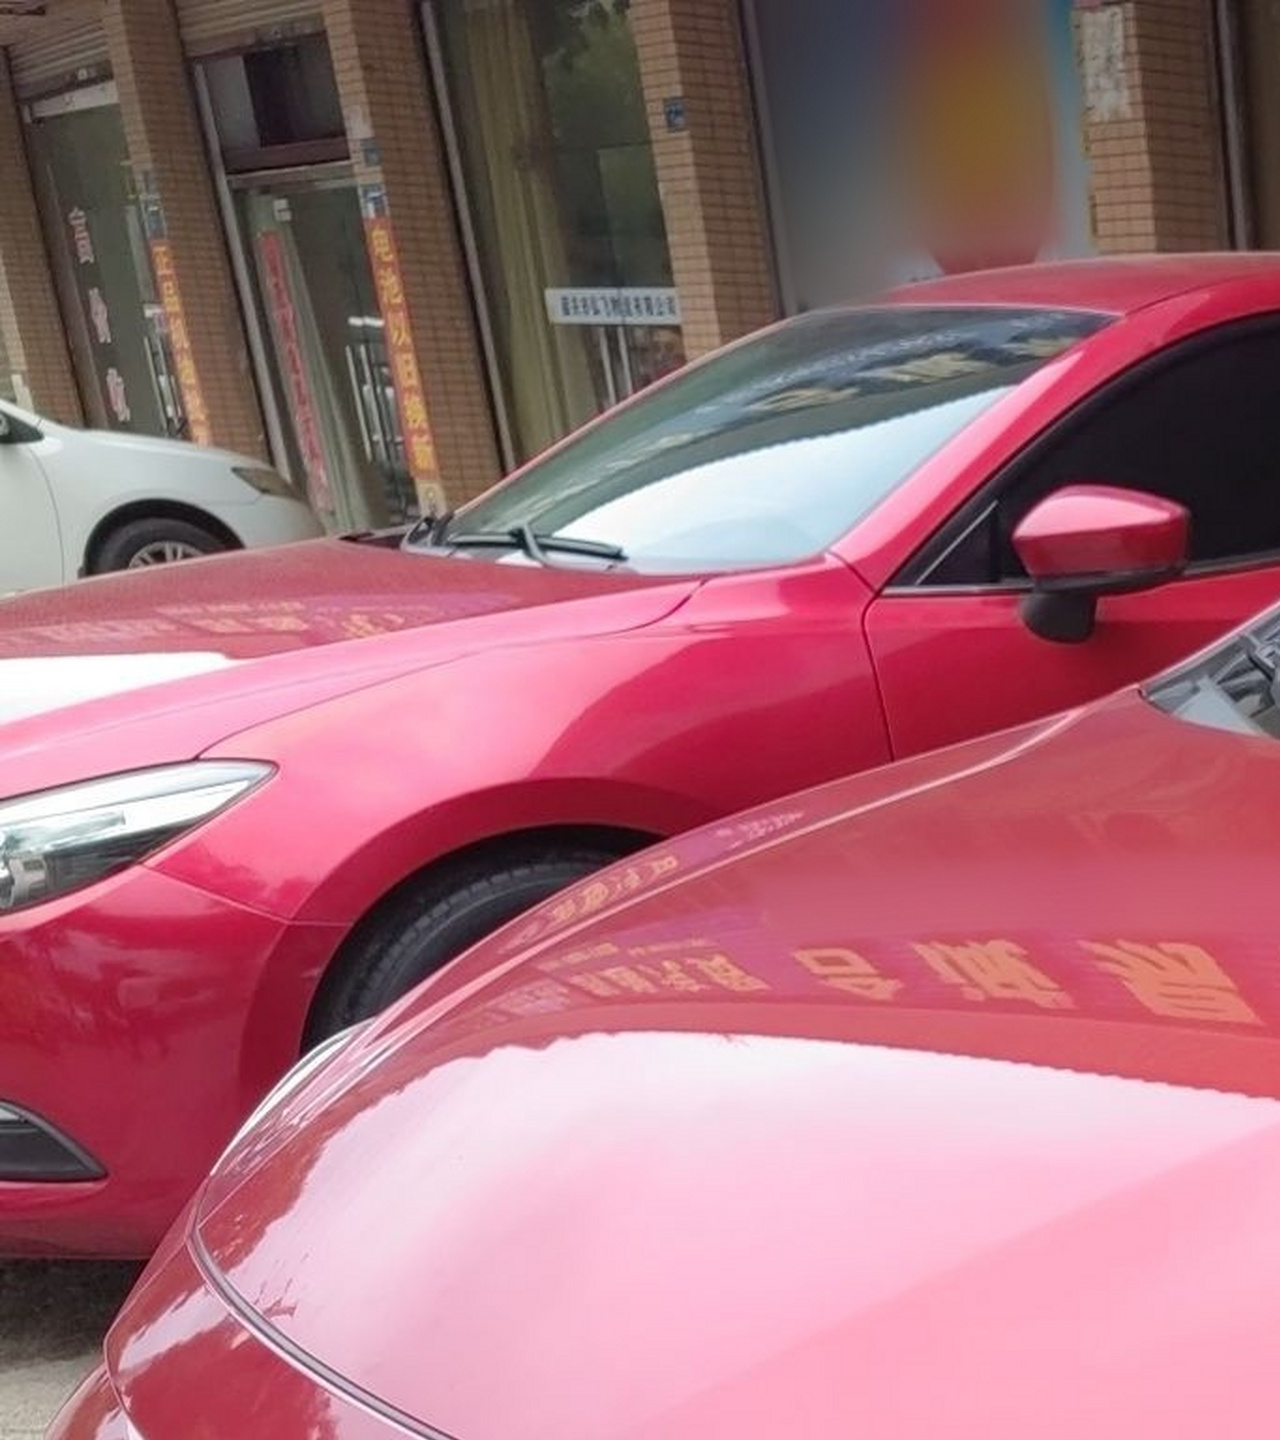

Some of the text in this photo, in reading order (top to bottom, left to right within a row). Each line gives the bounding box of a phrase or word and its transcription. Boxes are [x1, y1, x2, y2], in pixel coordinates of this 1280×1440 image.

[370, 228, 436, 471] 电池以旧换新
